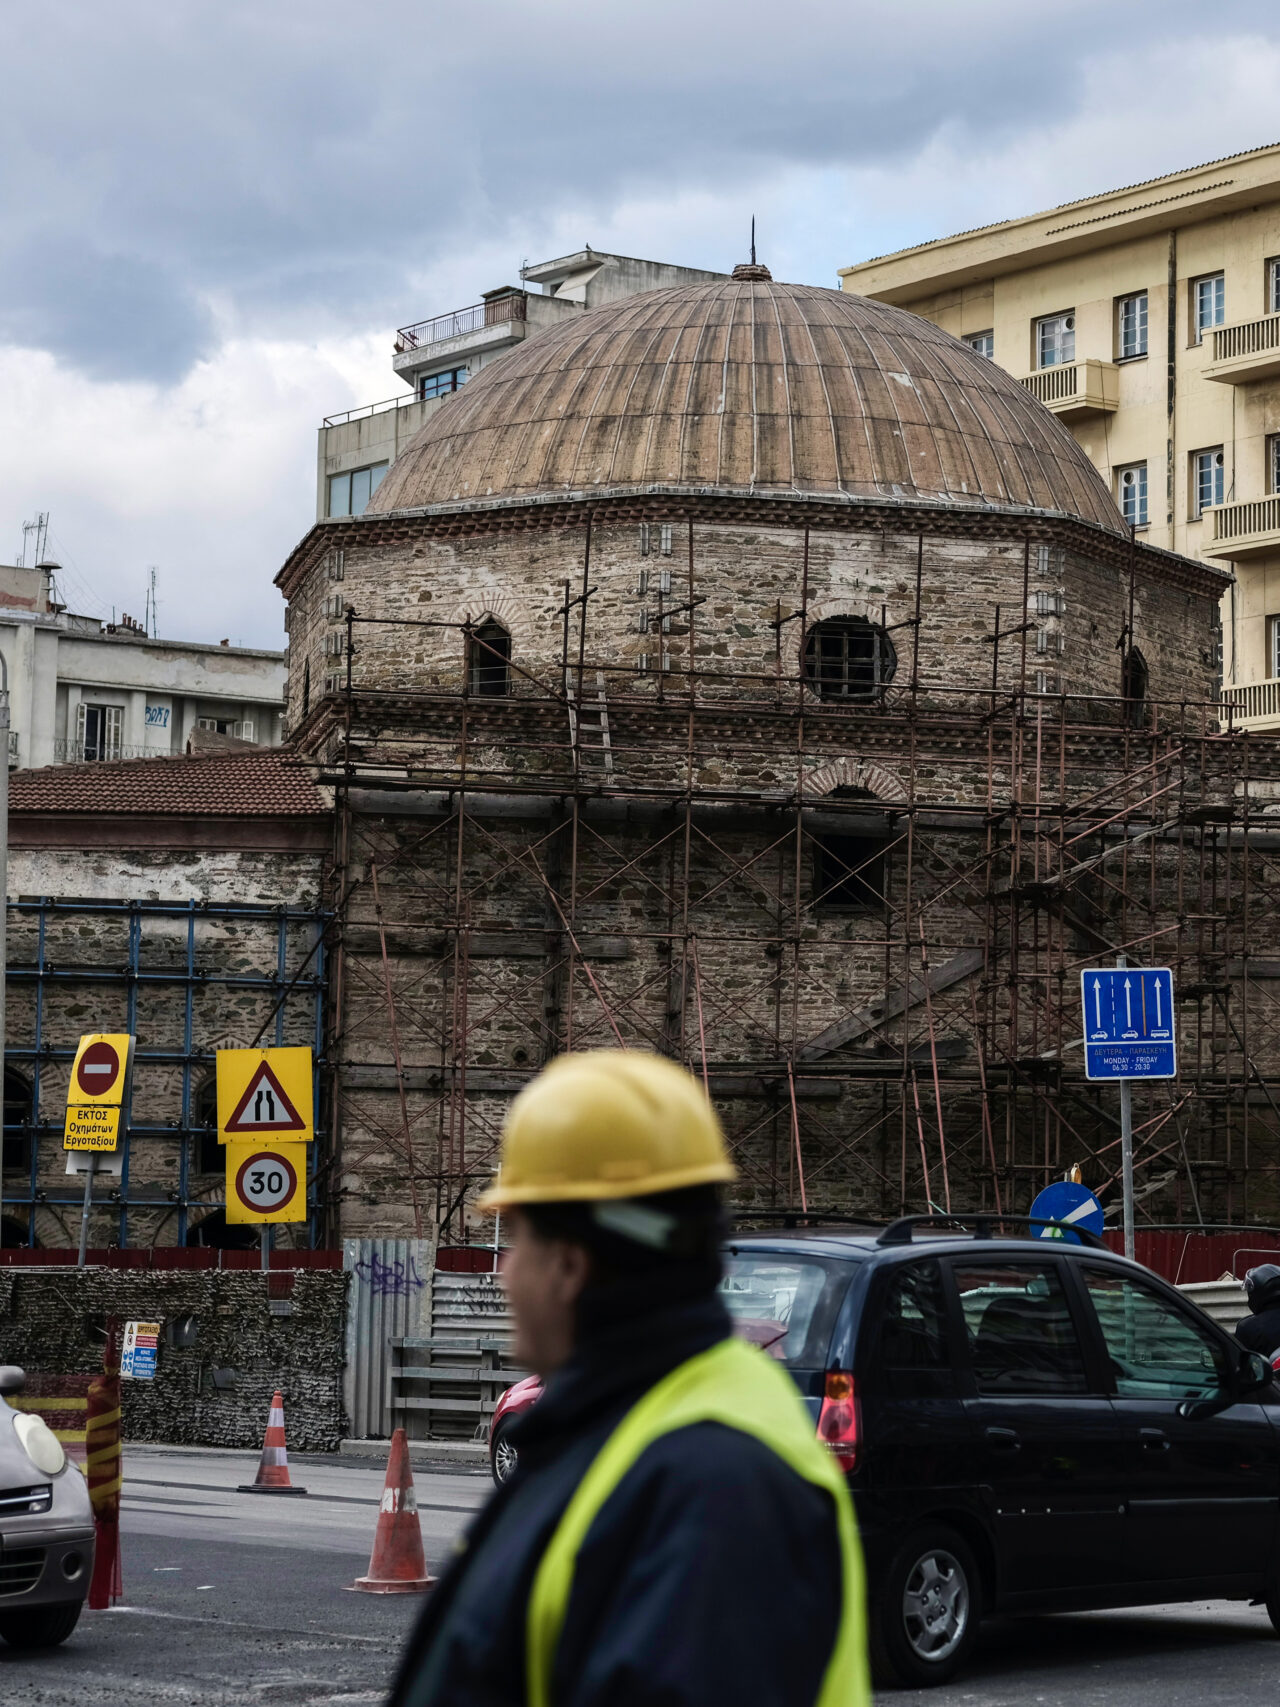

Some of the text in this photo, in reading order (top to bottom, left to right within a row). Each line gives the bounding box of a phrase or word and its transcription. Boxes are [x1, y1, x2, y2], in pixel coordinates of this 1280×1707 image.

[1094, 1048, 1123, 1056] ΔΕΥΤΕΡΑ
[1129, 1047, 1168, 1055] ΠΑΡΑΣΚΕΥΗ
[1103, 1057, 1130, 1065] MONDAY
[1135, 1056, 1158, 1064] FRIDAY
[77, 1110, 108, 1121] ΕΚΤΟΣ
[69, 1122, 113, 1134] Οχημάτων
[65, 1135, 115, 1148] Εργοταξίου
[249, 1171, 283, 1195] 30
